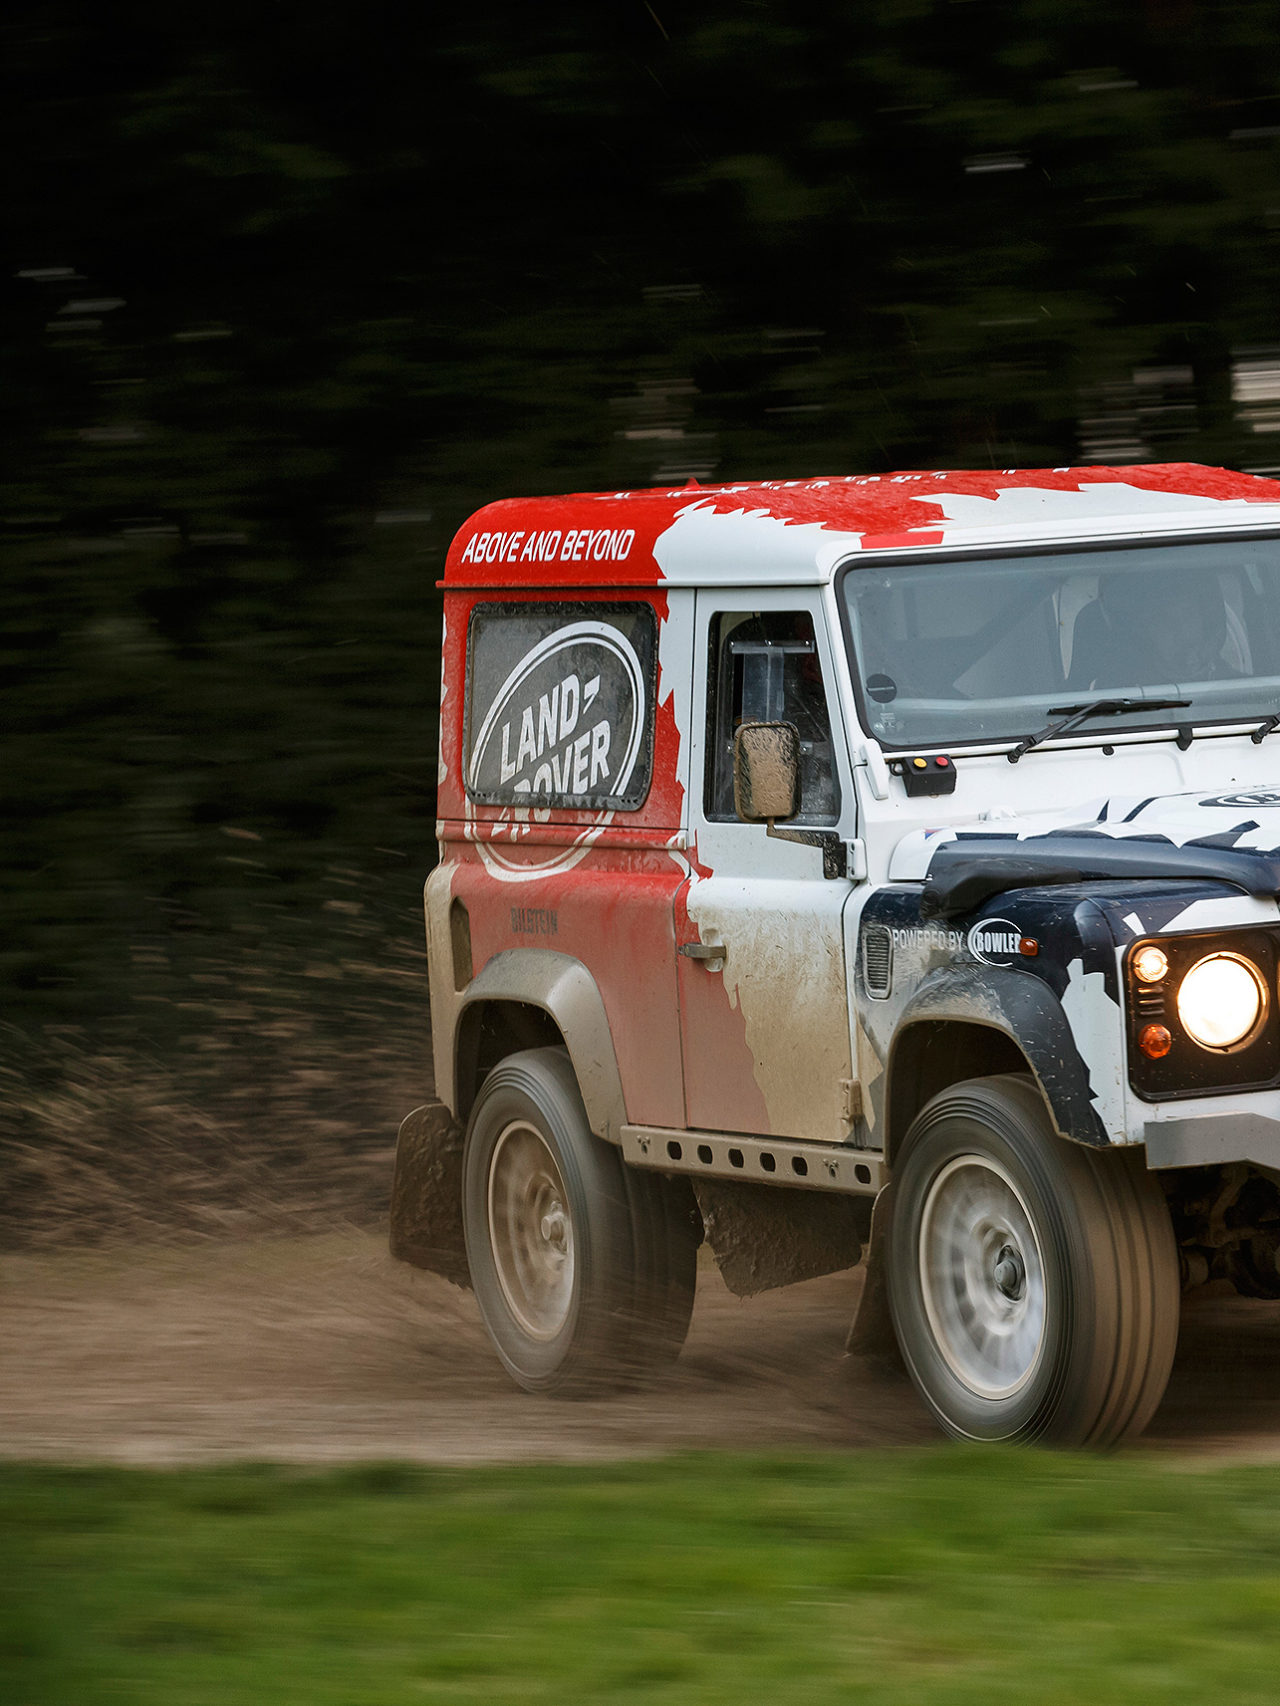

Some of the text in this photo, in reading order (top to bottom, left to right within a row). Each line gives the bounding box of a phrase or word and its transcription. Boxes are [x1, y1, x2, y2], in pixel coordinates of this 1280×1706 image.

[461, 528, 636, 563] ABOVE AND BEYOND
[892, 929, 945, 950] POWERED
[948, 930, 964, 952] BY
